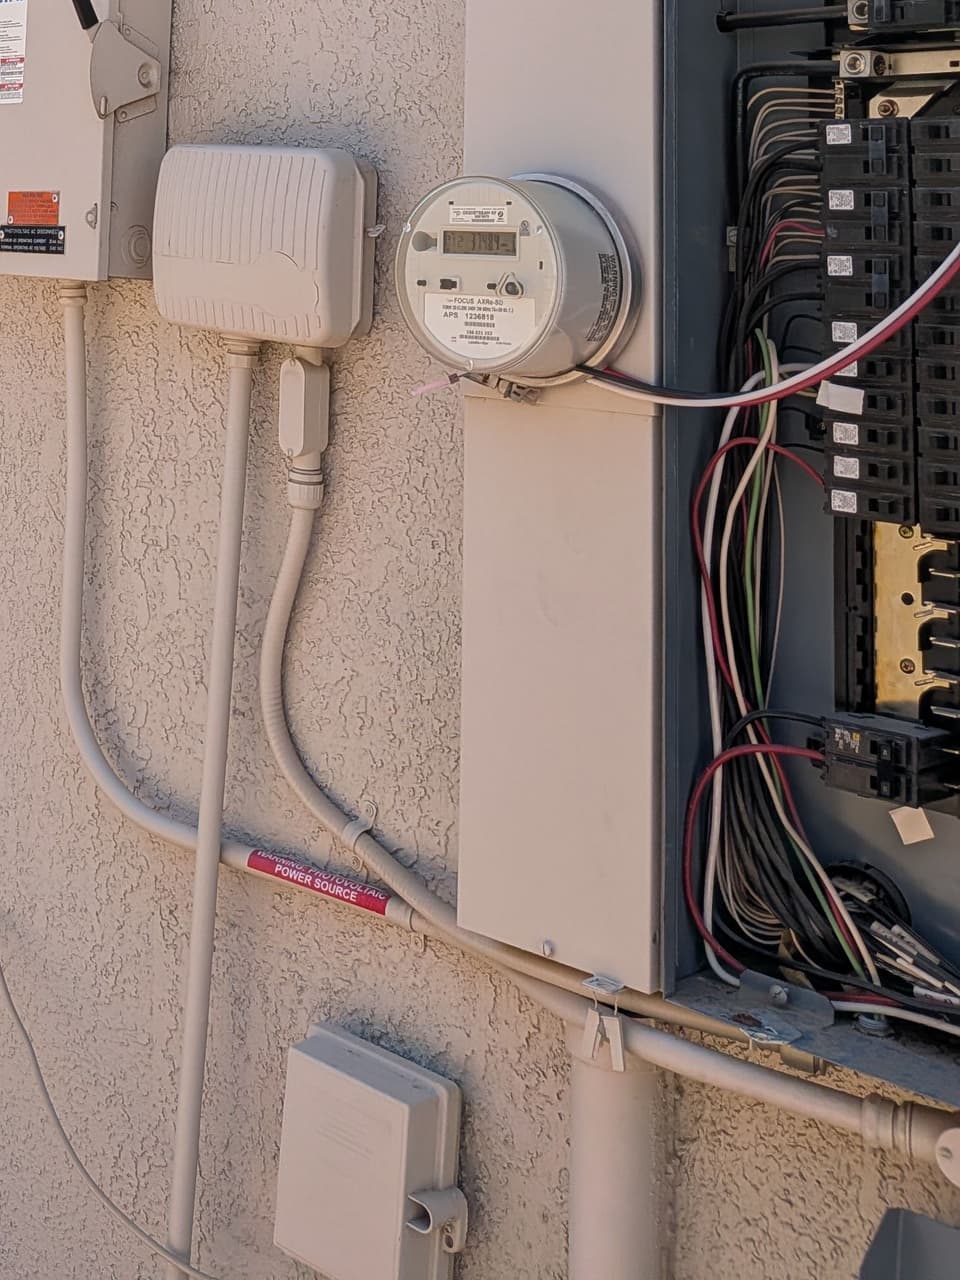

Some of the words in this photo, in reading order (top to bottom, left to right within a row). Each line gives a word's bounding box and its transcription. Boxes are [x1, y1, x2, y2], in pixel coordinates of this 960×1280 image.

[453, 297, 475, 305] FOCUS
[443, 311, 459, 319] APS
[274, 864, 312, 887] POWER
[313, 878, 358, 902] SOURCE
